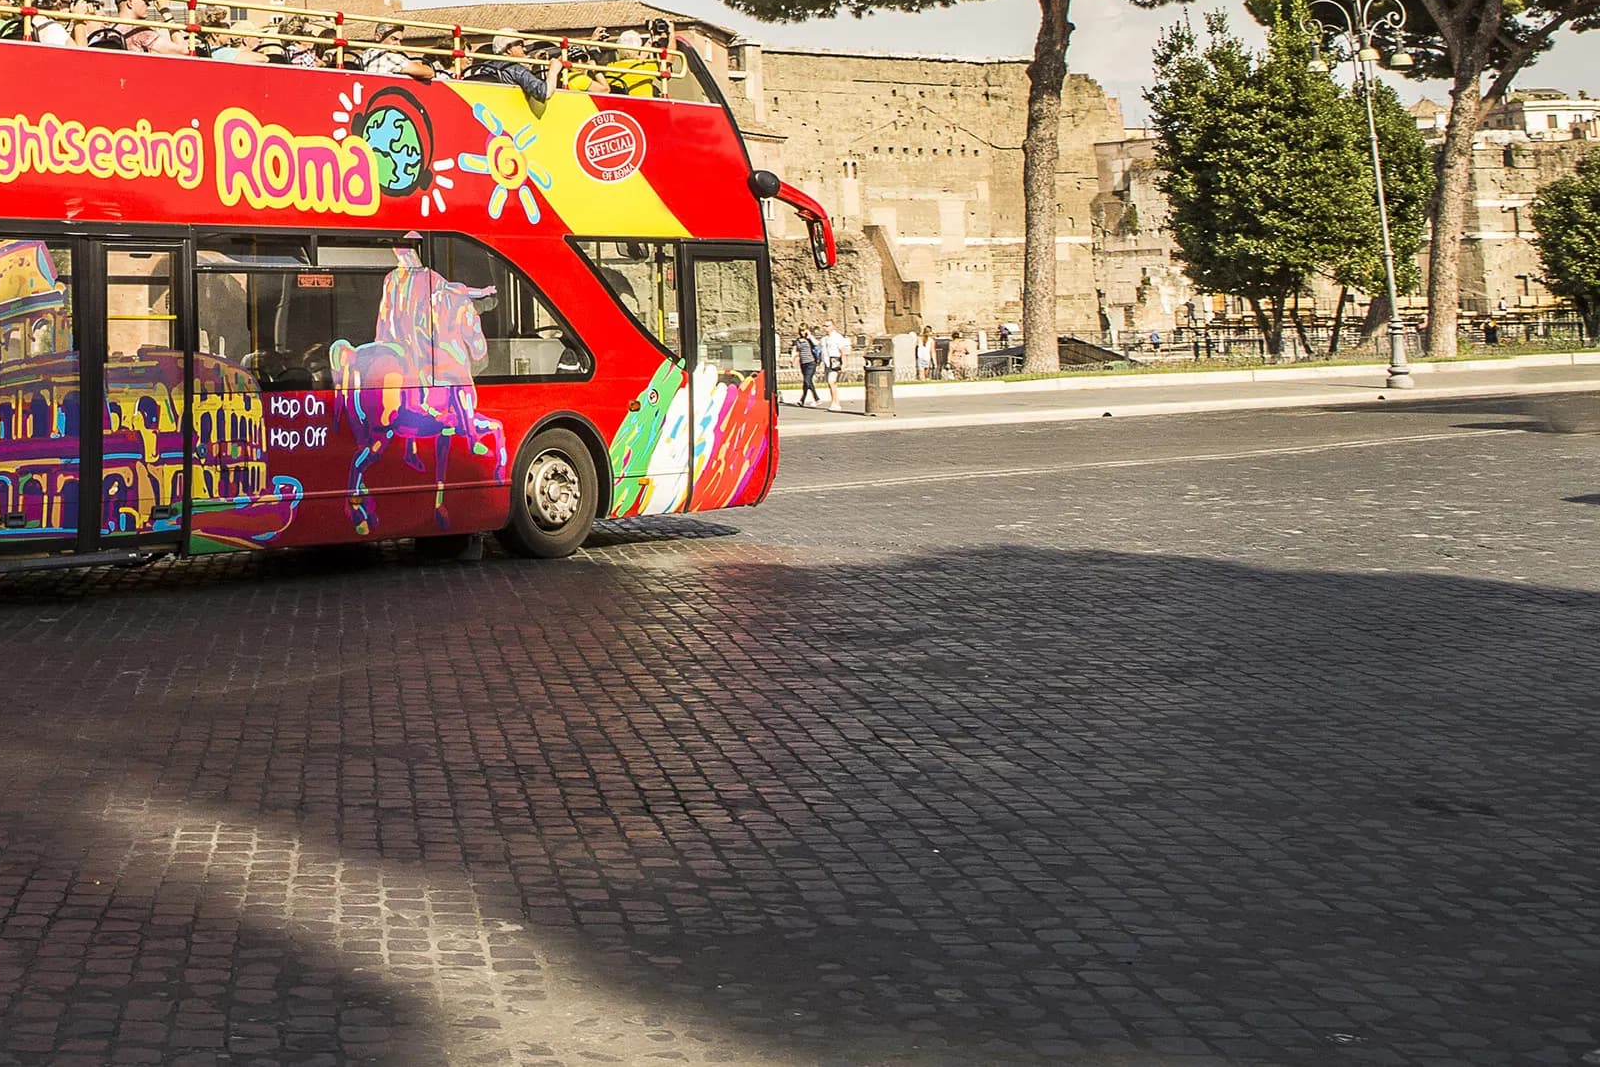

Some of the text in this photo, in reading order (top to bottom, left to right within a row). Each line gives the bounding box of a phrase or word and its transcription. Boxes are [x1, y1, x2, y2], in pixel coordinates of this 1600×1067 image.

[591, 114, 616, 127] TOUR
[587, 135, 633, 158] OFFICIAL
[214, 106, 380, 216] Roma
[601, 162, 636, 181] OF ROMA
[270, 394, 325, 418] Hop On
[270, 426, 328, 450] Hop Off
